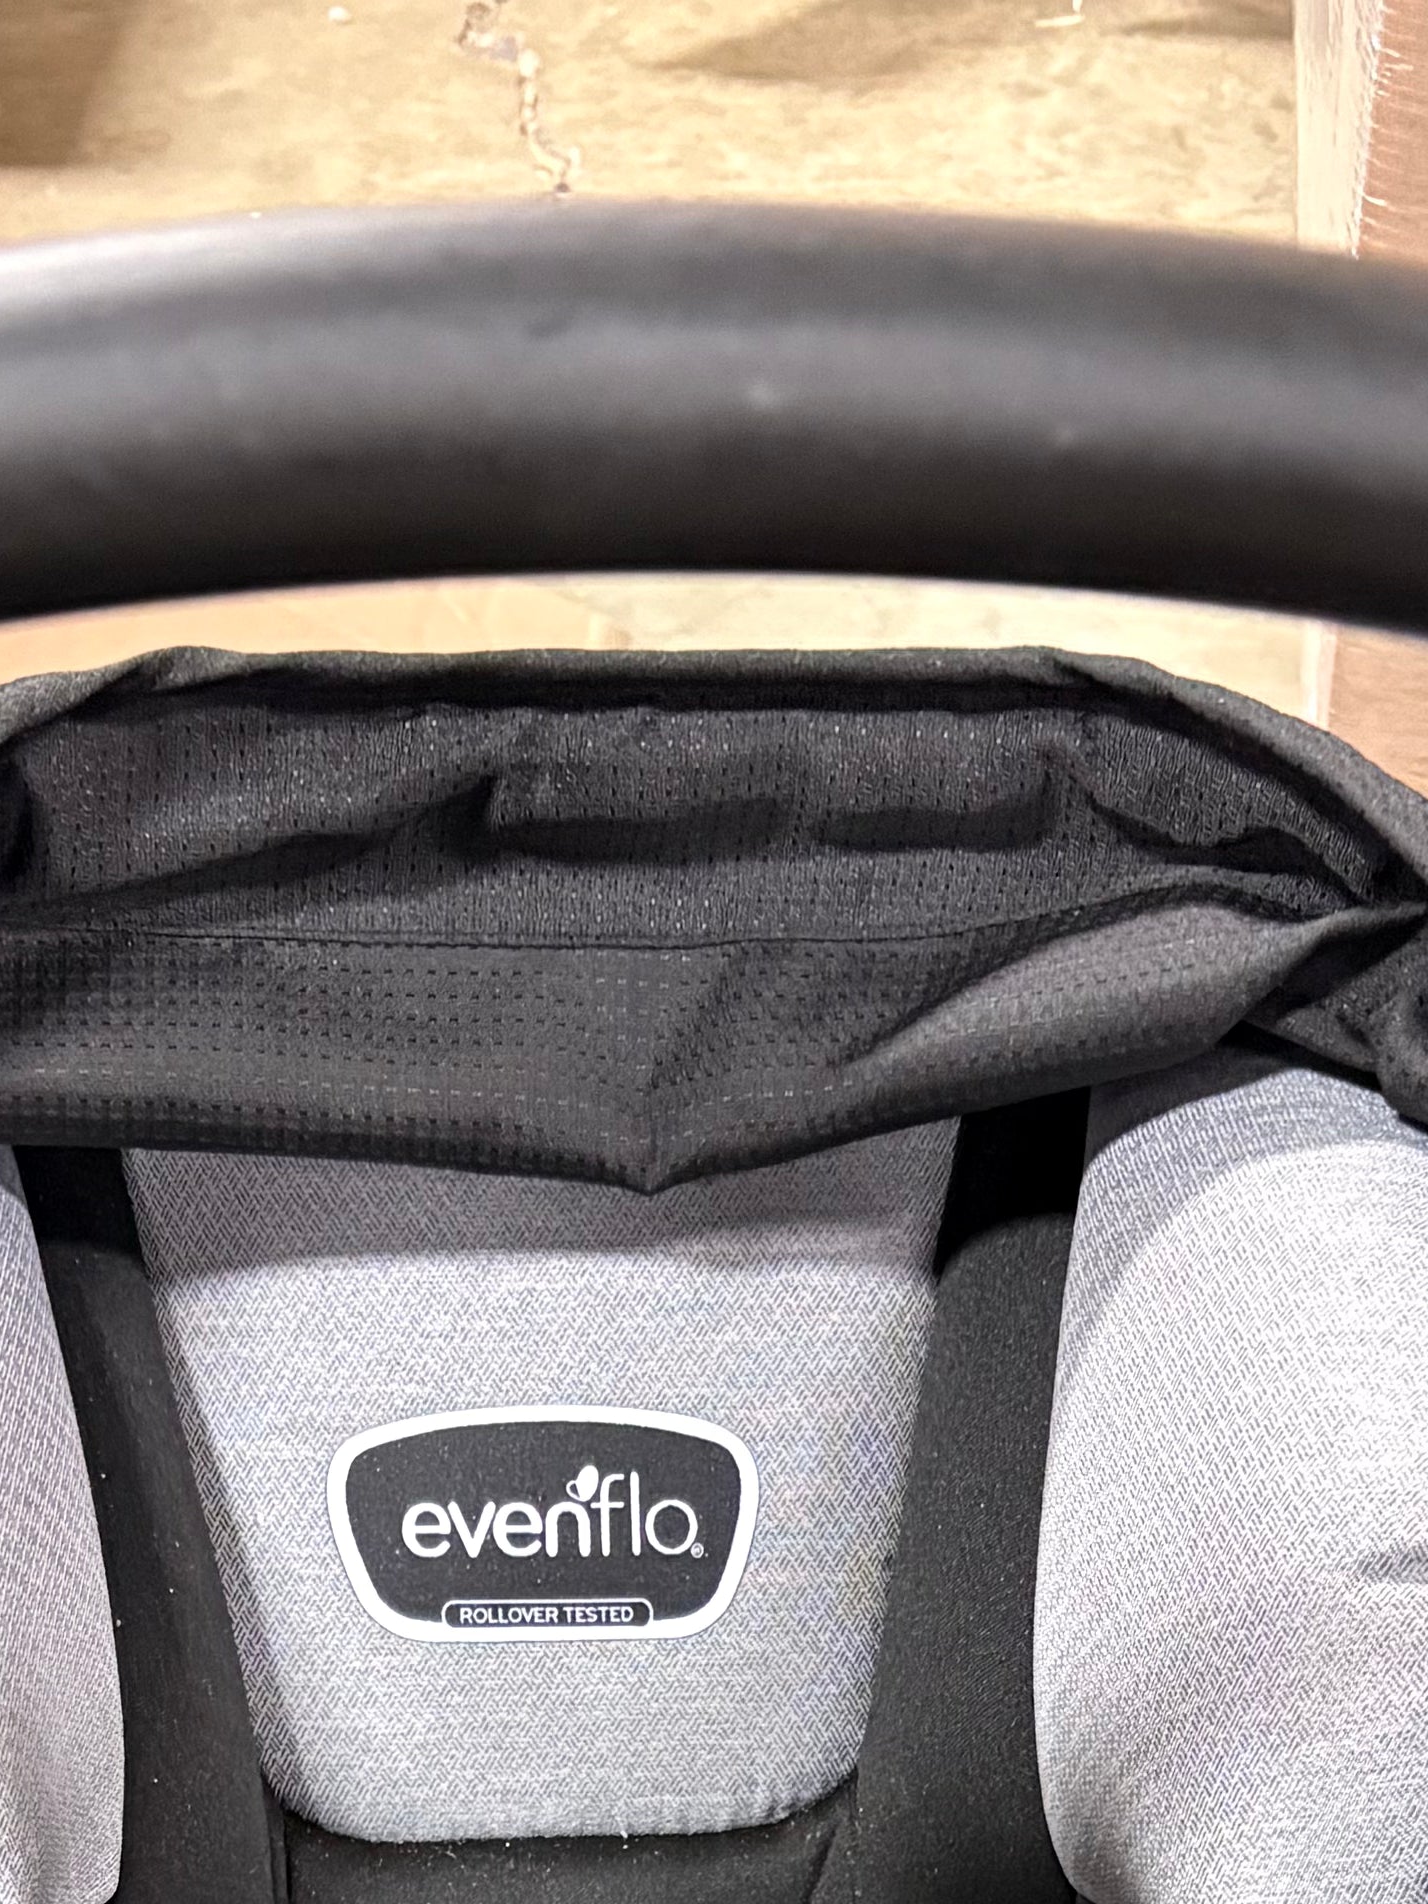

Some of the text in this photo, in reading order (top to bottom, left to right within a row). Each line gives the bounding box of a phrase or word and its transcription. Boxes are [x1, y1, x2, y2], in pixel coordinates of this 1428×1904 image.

[401, 1467, 699, 1557] evenflo
[459, 1605, 634, 1625] ROLLOVER TESTED
